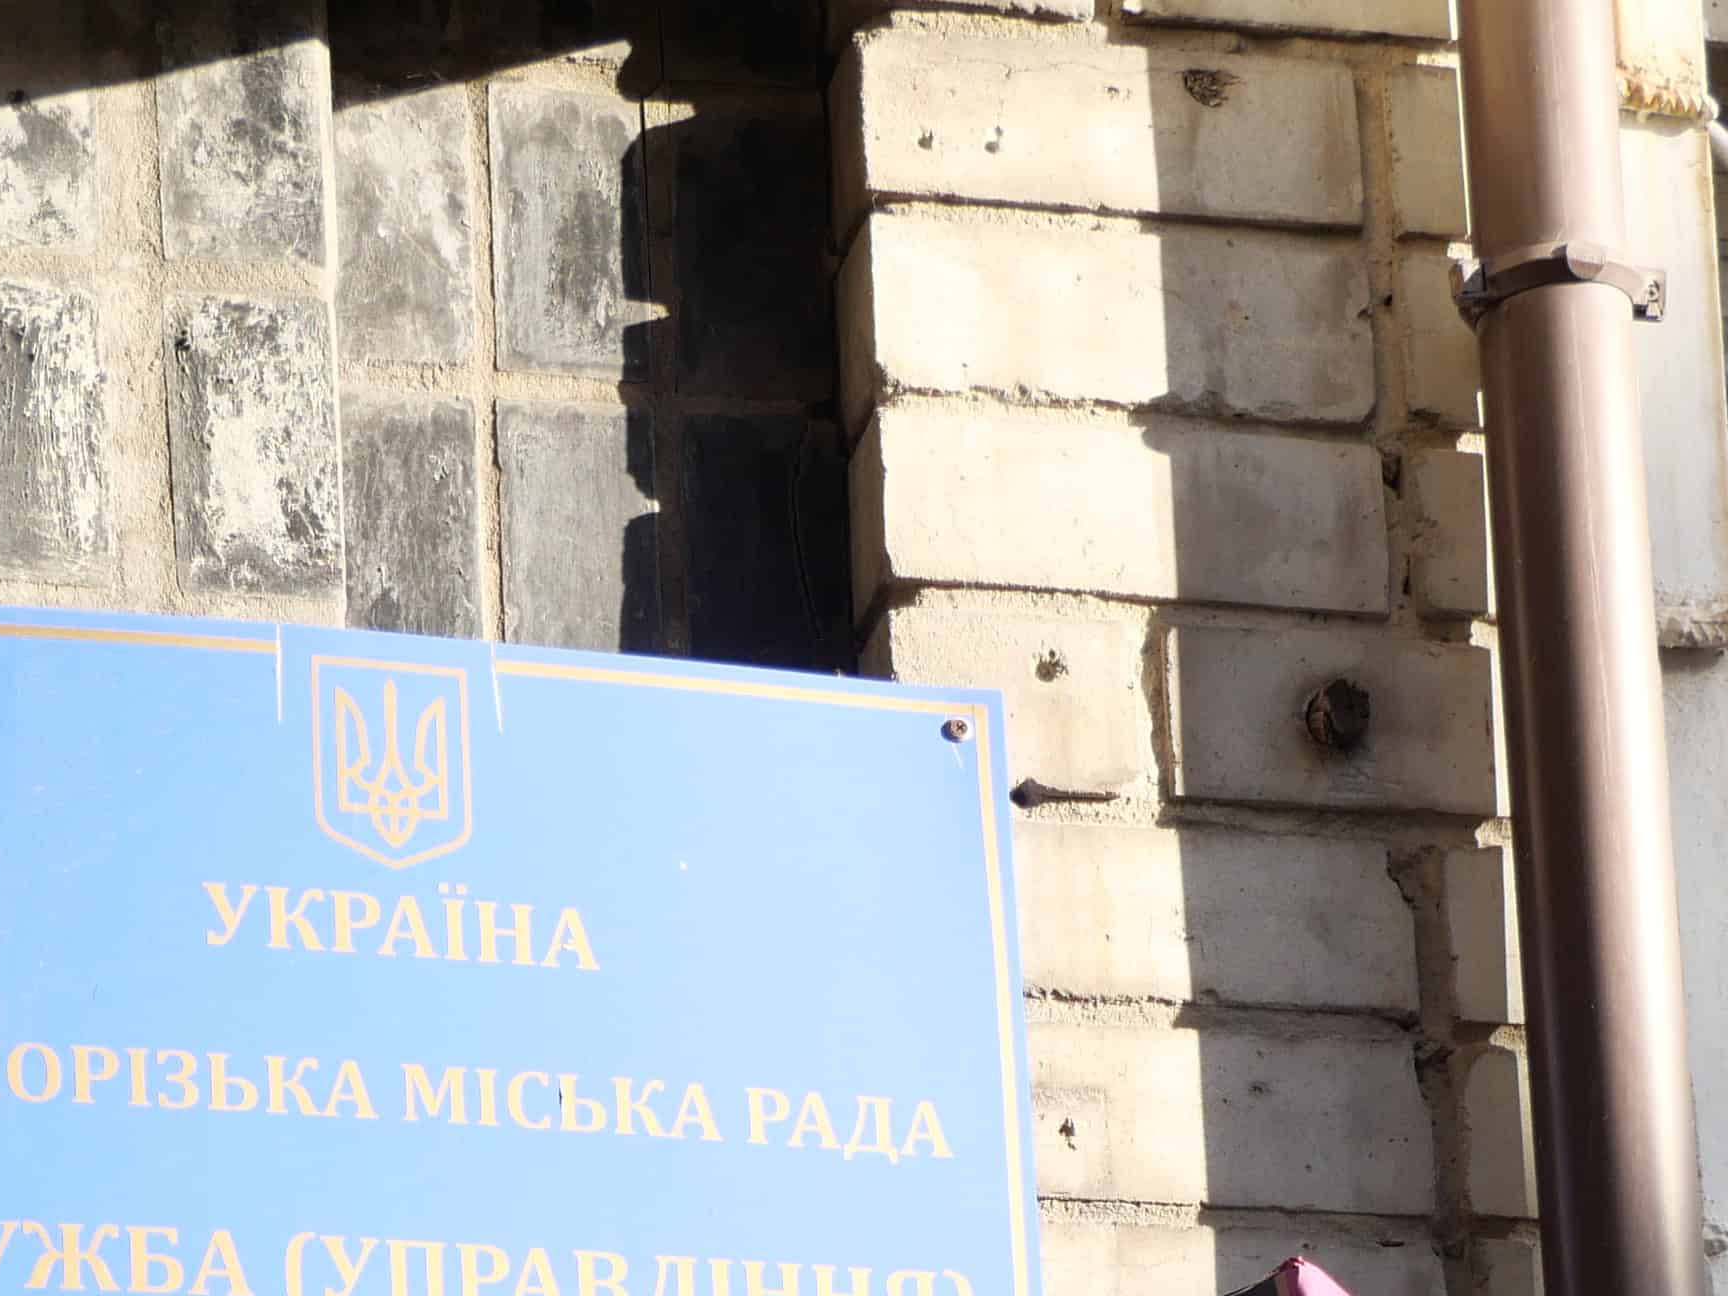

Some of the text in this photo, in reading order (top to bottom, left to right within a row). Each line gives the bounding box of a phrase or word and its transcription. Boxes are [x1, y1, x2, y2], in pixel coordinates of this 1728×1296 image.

[202, 879, 599, 971] УКРАЇНА
[401, 1063, 723, 1142] МІСЬКА
[745, 1087, 954, 1165] РАДА
